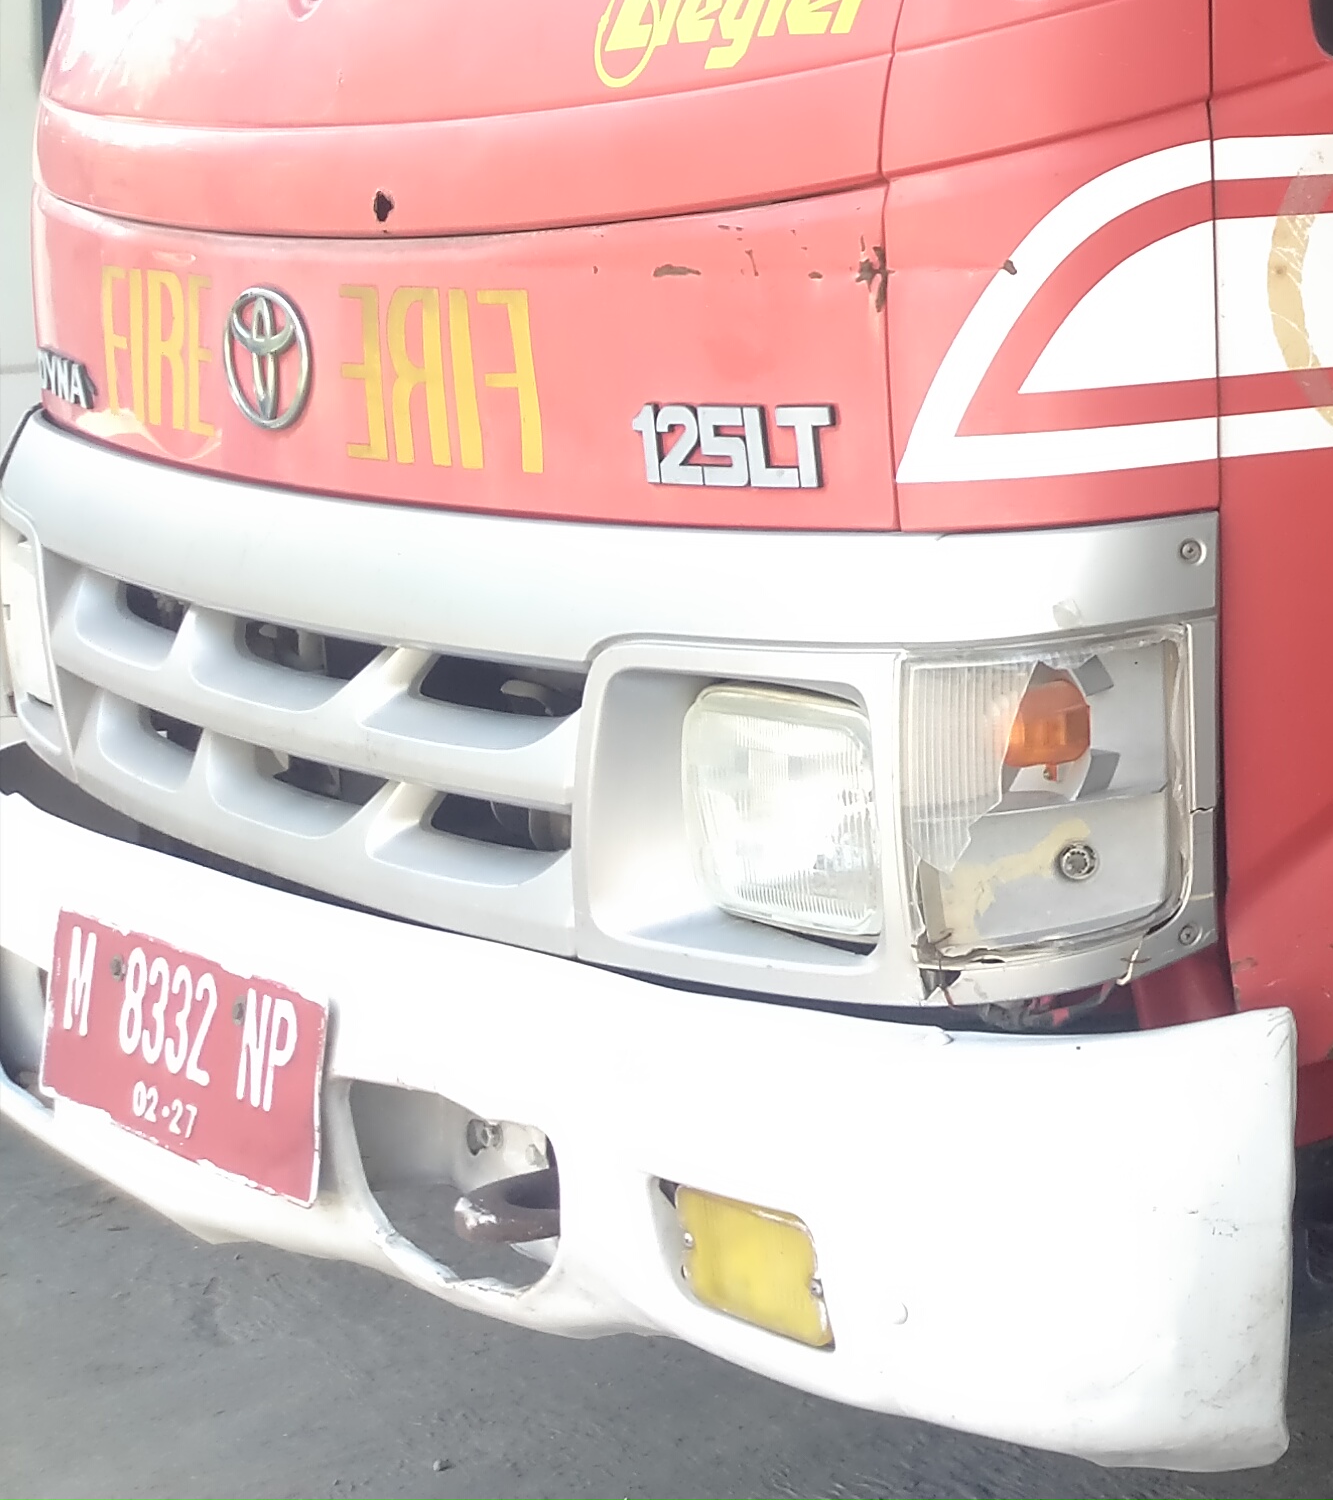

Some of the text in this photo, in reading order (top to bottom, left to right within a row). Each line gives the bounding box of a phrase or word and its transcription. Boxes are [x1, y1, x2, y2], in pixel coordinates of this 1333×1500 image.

[38, 350, 93, 409] DYNA
[101, 265, 217, 438] FIRE
[631, 403, 837, 488] 125LT
[63, 926, 298, 1112] M 8332 NP
